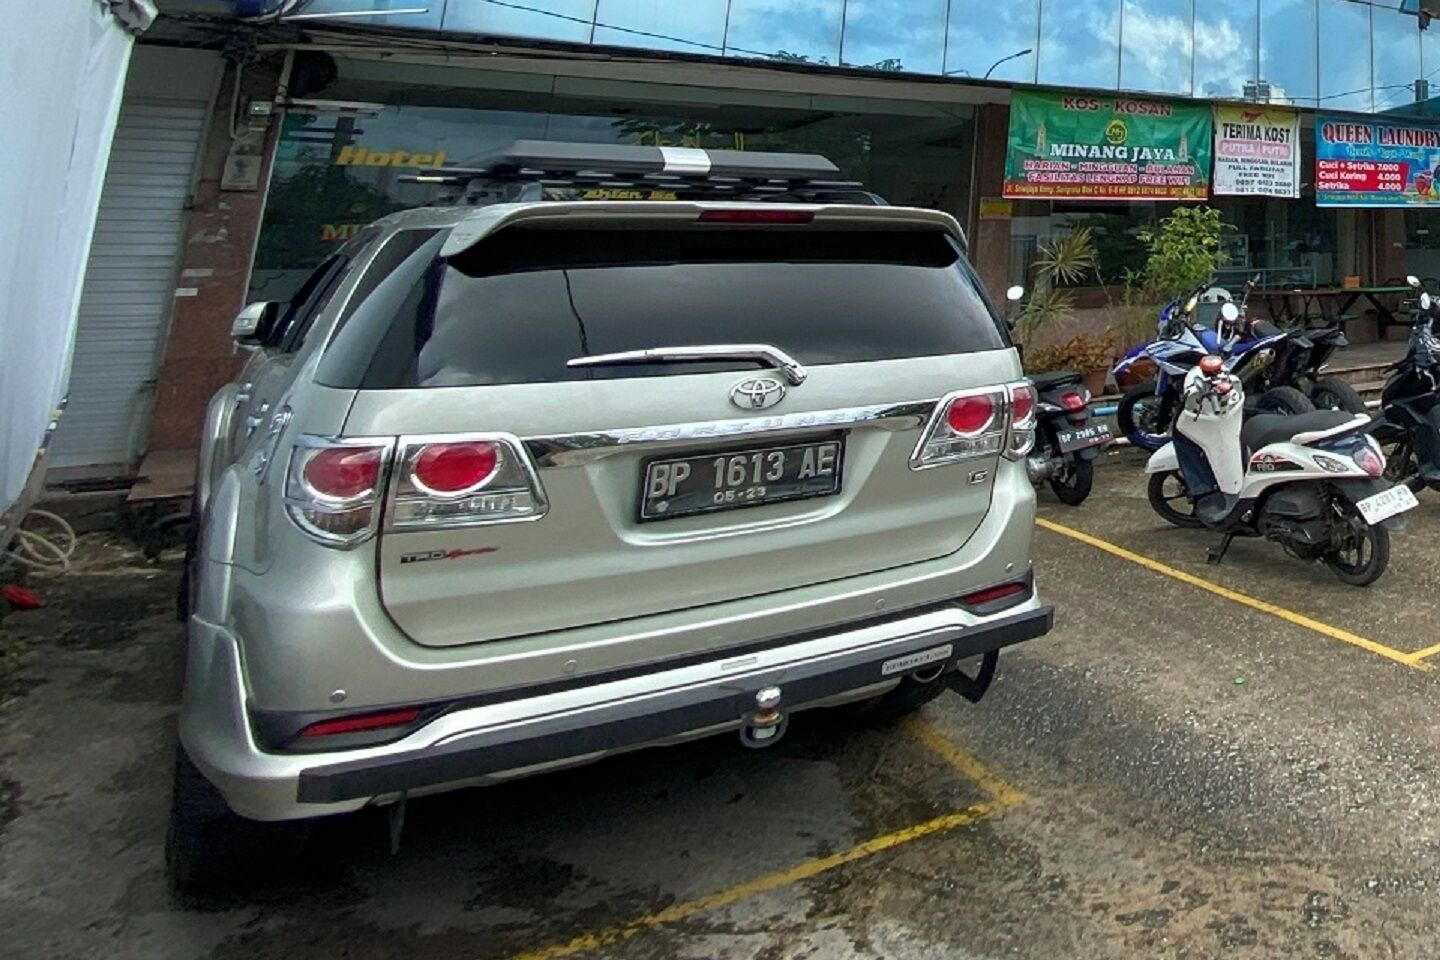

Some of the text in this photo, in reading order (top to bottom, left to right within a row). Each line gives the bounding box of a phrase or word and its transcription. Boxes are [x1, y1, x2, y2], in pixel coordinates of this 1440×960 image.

[1062, 97, 1100, 111] KOS
[1113, 100, 1172, 117] KOSAN
[1222, 122, 1291, 144] TERIMA KOST
[1322, 122, 1374, 144] QUEEN
[336, 145, 448, 169] Hotel
[1050, 143, 1175, 162] MINANG JAYA
[1024, 160, 1070, 171] HARIAN
[1319, 161, 1339, 169] Cuci
[1346, 162, 1375, 170] Setrika
[1377, 163, 1399, 171] 7.000
[1318, 171, 1339, 180] Cuci
[1340, 172, 1367, 182] Kering
[1318, 181, 1350, 190] Setrika
[651, 445, 836, 498] BP 1613 AE
